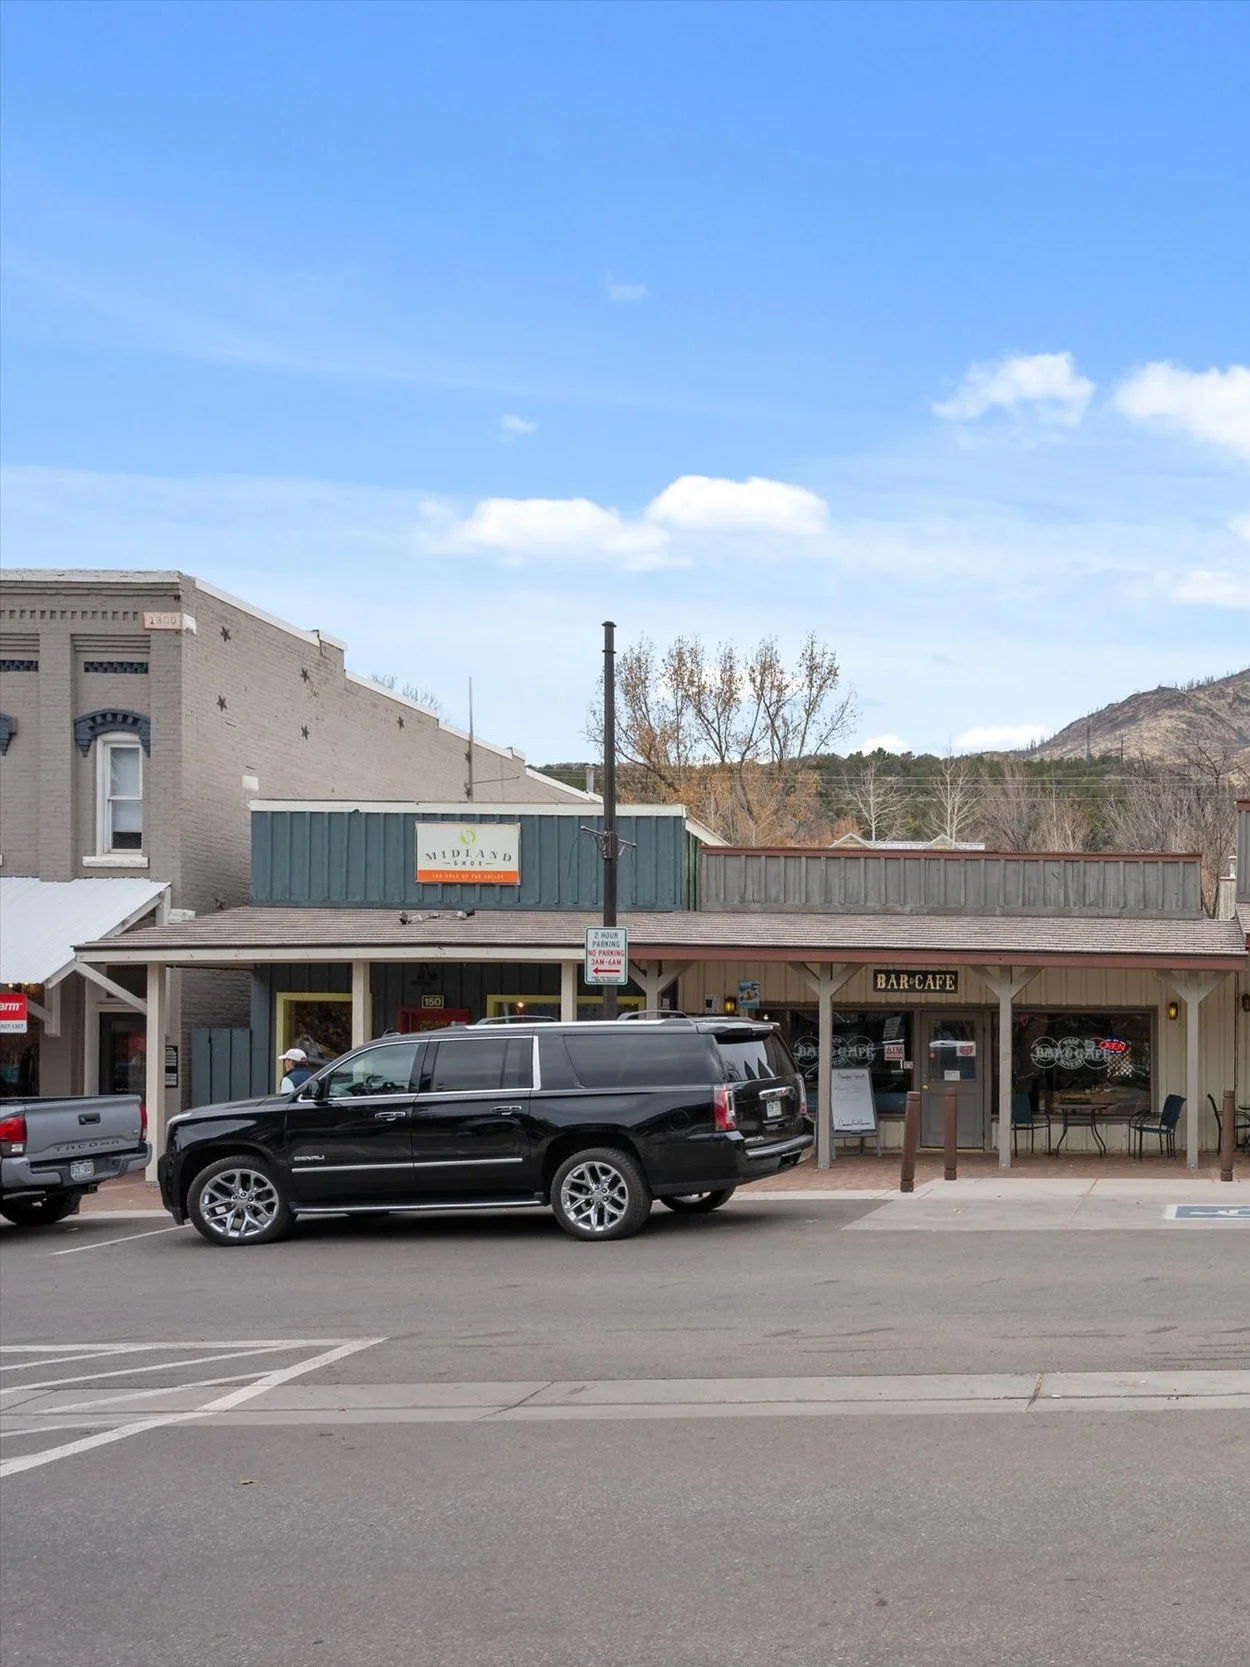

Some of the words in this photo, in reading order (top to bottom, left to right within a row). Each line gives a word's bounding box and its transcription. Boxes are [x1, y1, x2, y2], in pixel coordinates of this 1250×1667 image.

[425, 848, 512, 862] MIDLAND
[876, 973, 909, 989] BAR
[914, 974, 955, 990] CAFE
[424, 997, 441, 1006] 150
[886, 1046, 904, 1054] ATM
[1099, 1040, 1126, 1052] OPEN
[1035, 1047, 1063, 1059] BAR
[56, 1140, 119, 1152] TACOMA
